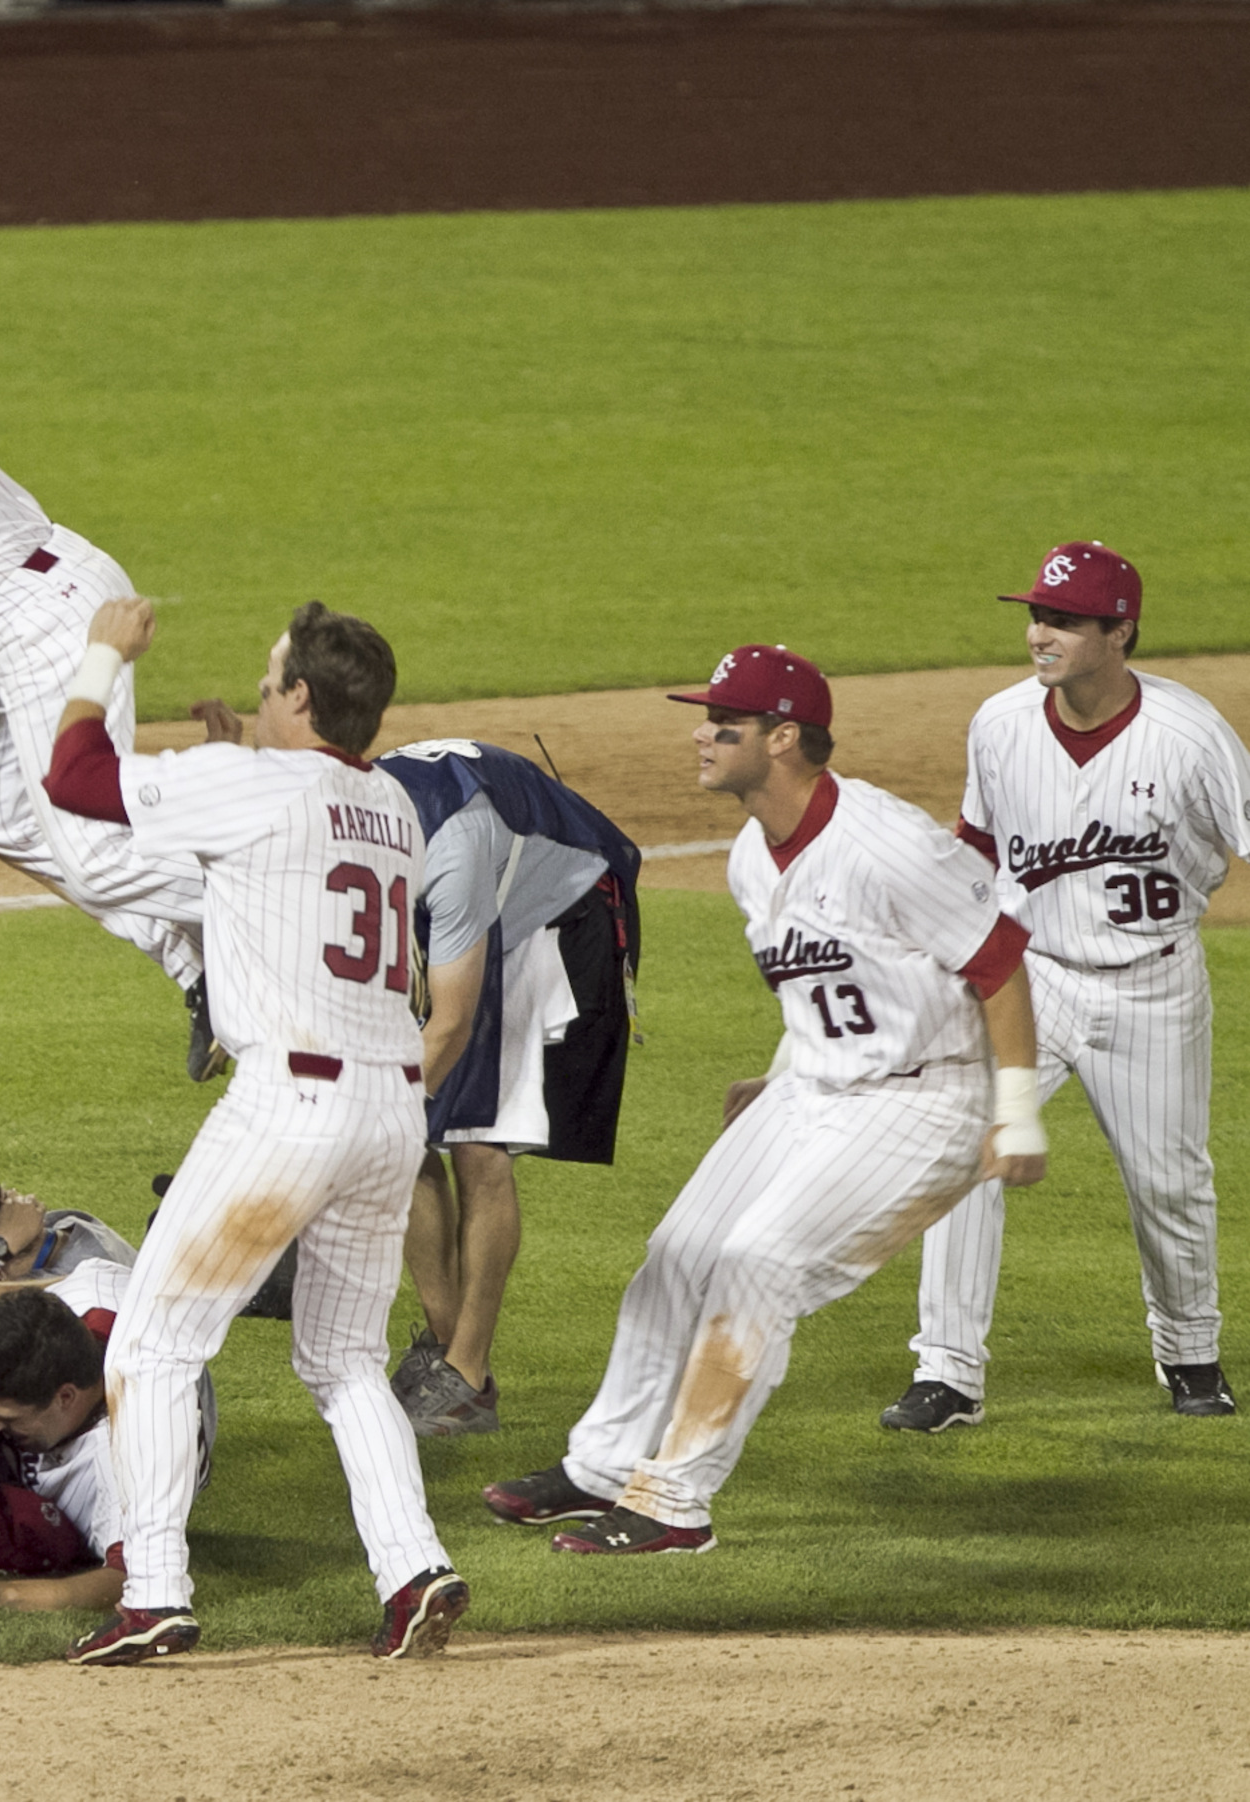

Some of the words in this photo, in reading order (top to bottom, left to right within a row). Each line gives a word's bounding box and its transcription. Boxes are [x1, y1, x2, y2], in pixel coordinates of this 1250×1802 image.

[327, 804, 412, 858] MARZILLI
[1009, 820, 1169, 873] Carolina
[1105, 871, 1181, 925] 36
[323, 862, 409, 995] 31
[811, 984, 877, 1038] 13
